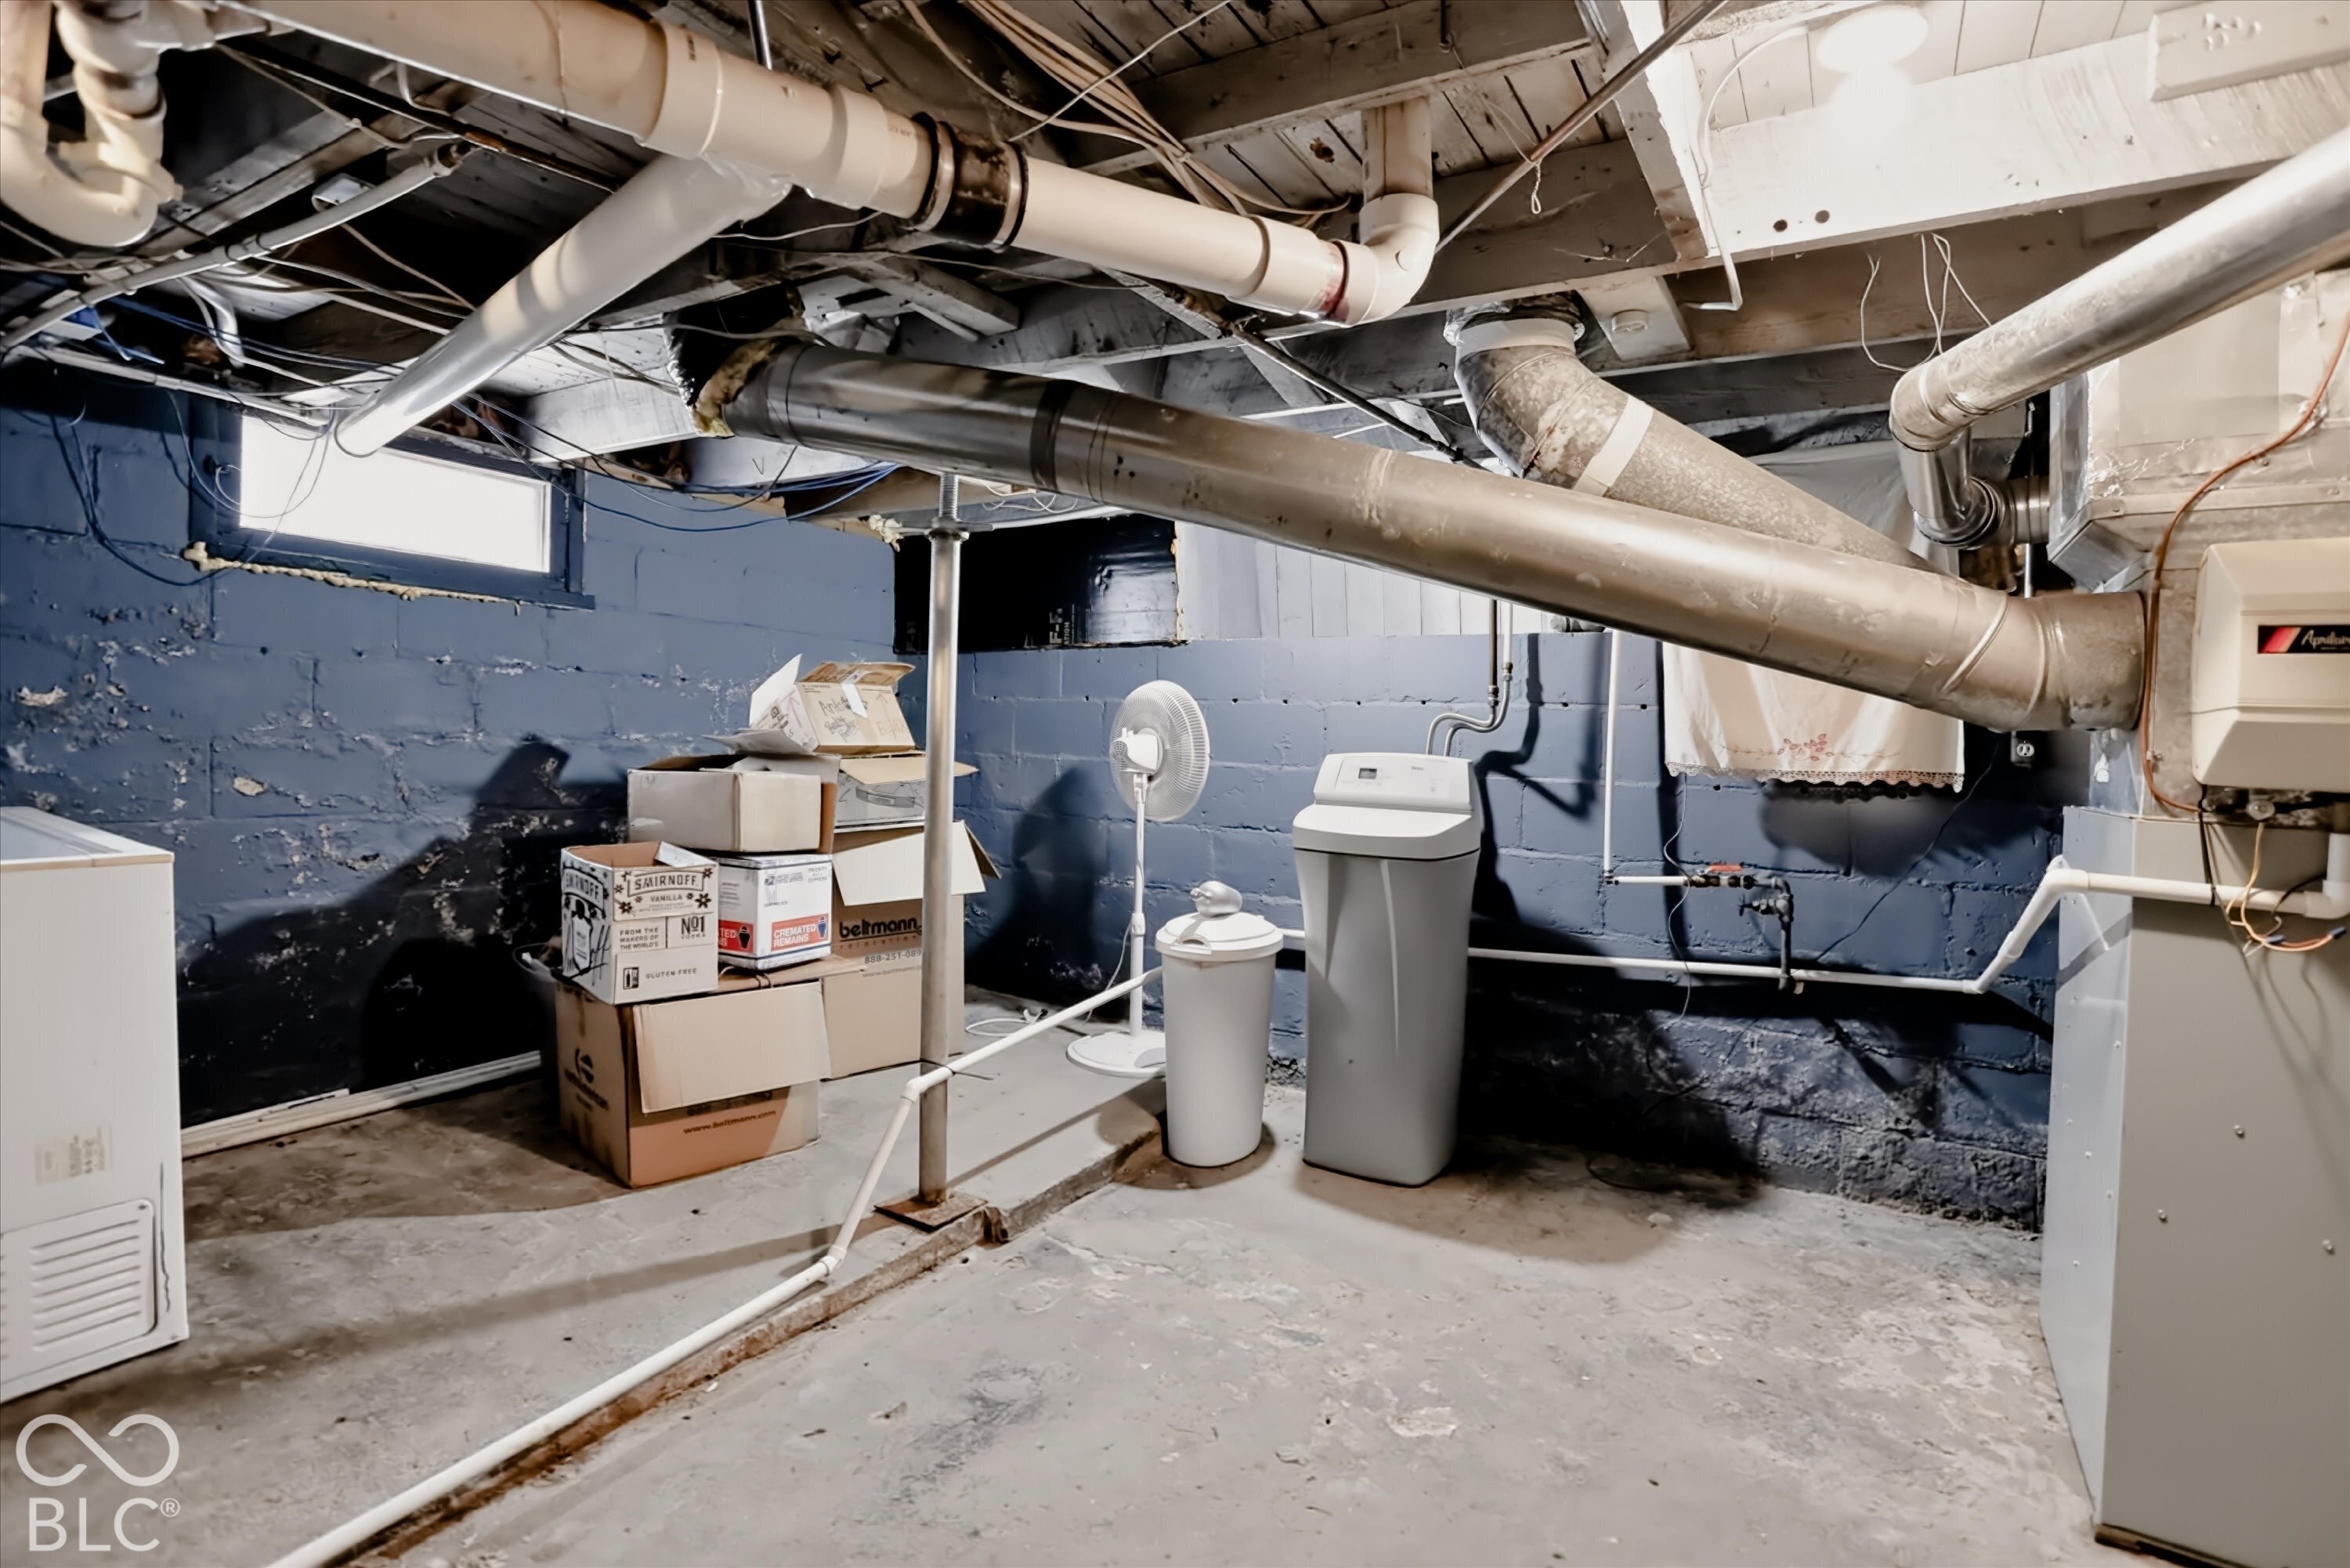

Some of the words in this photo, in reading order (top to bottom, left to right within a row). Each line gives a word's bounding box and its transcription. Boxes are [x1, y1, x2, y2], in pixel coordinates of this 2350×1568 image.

[634, 874, 696, 891] SMIRNOFF
[773, 923, 816, 938] CREMATED
[839, 917, 917, 938] beltmann
[773, 934, 809, 948] REMAINS
[865, 949, 921, 964] 888-251-089
[645, 970, 675, 979] GLUTEN
[682, 1110, 776, 1135] www.beltmann.com
